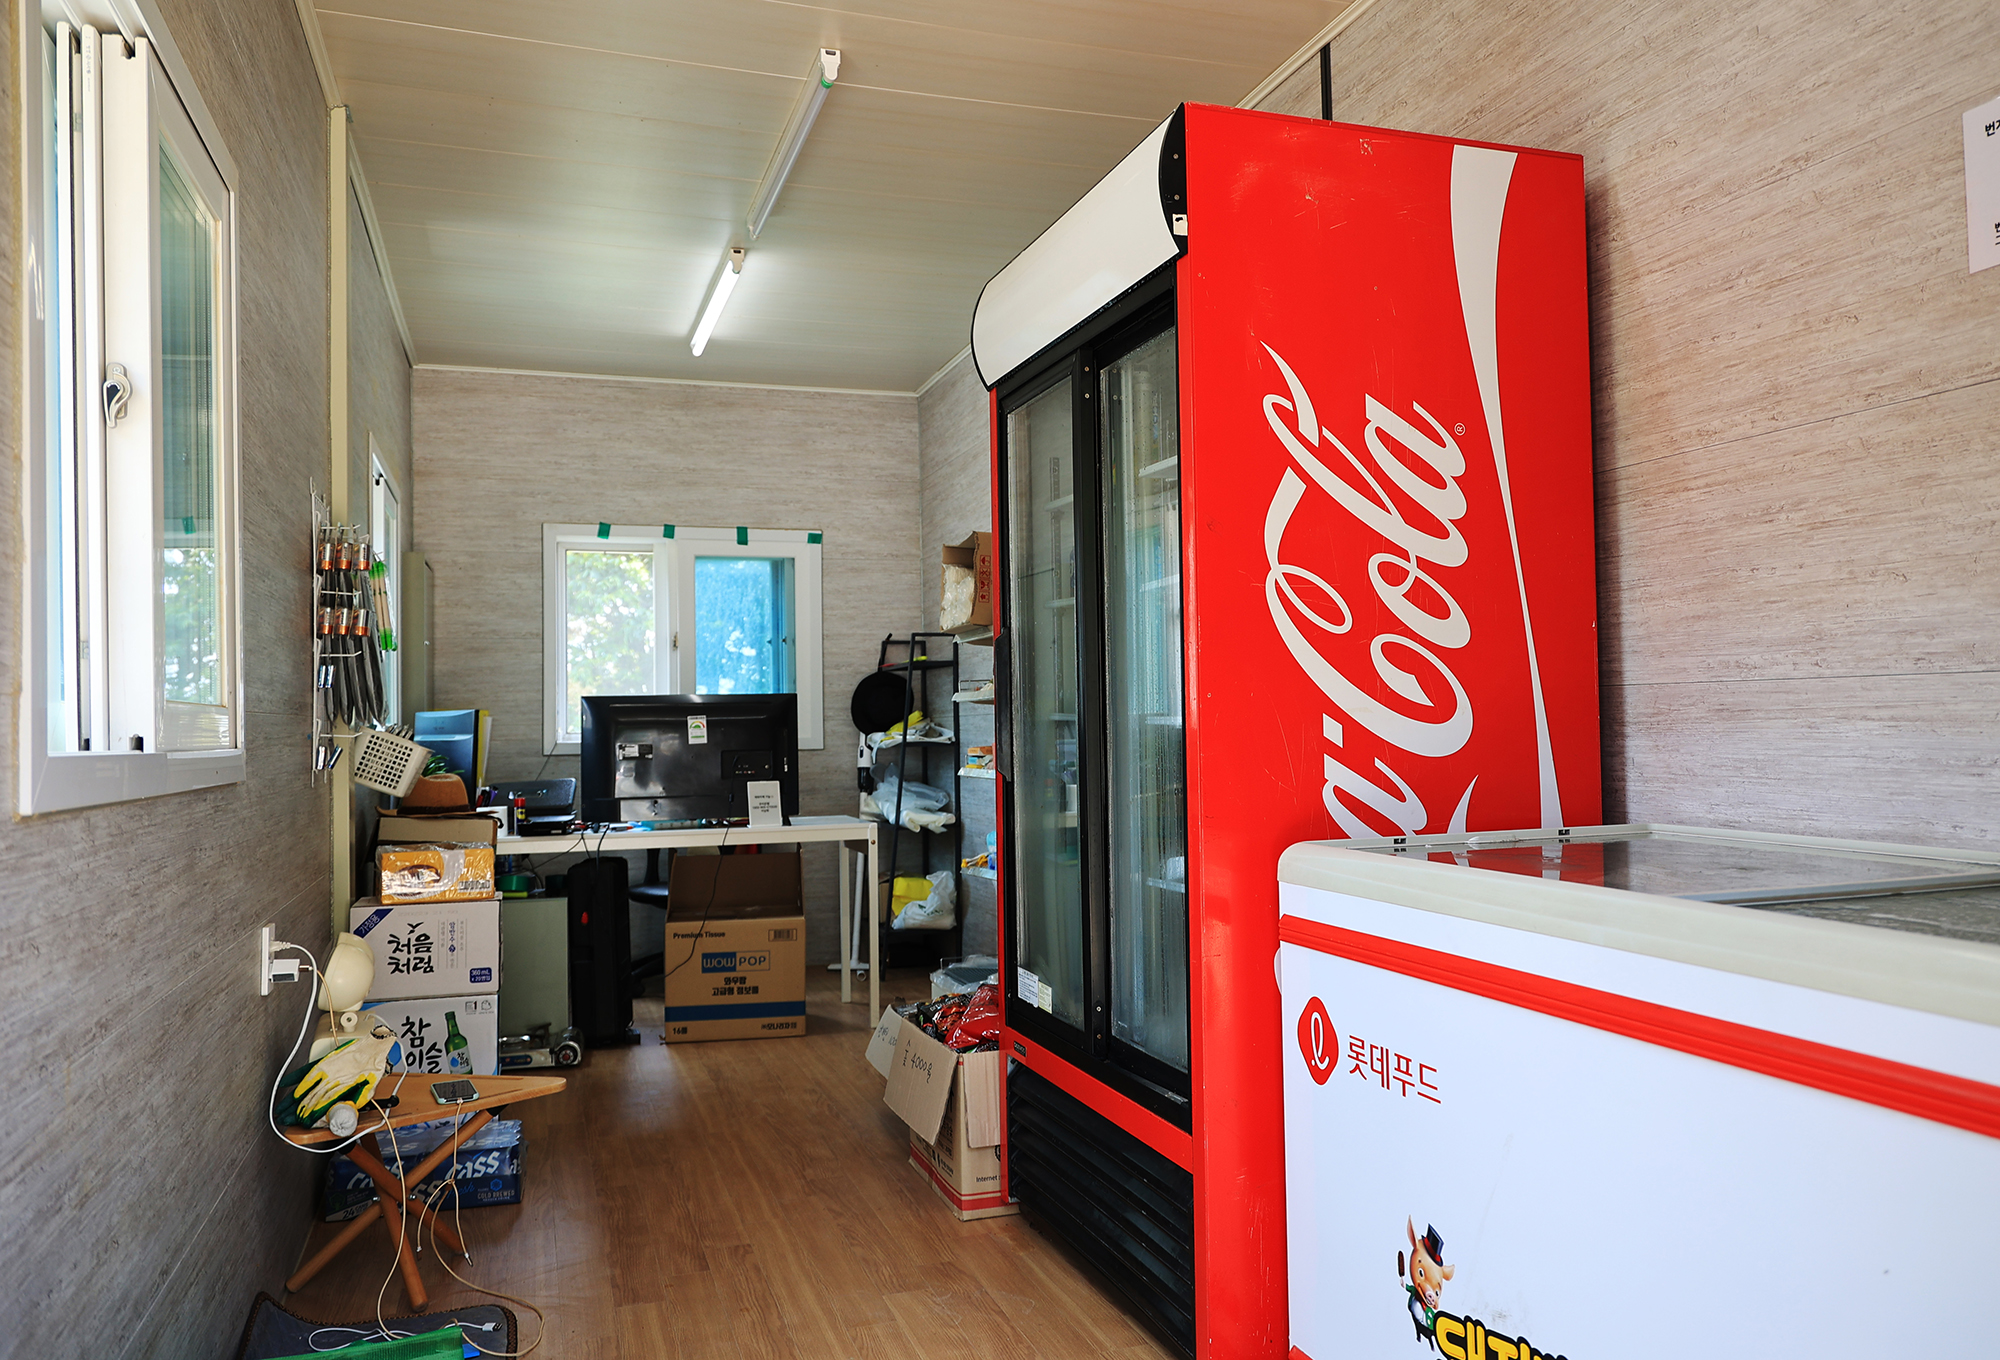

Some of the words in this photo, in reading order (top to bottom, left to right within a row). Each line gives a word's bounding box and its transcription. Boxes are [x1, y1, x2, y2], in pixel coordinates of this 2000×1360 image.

[1260, 340, 1475, 839] a-Cola
[387, 932, 434, 955] 처음
[387, 955, 435, 975] 처럼
[703, 956, 735, 968] WOW
[738, 956, 766, 966] POP
[400, 1015, 432, 1049] 참
[404, 1041, 442, 1074] 이슬
[1347, 1033, 1442, 1105] 롯데푸드
[976, 1175, 998, 1183] Internet
